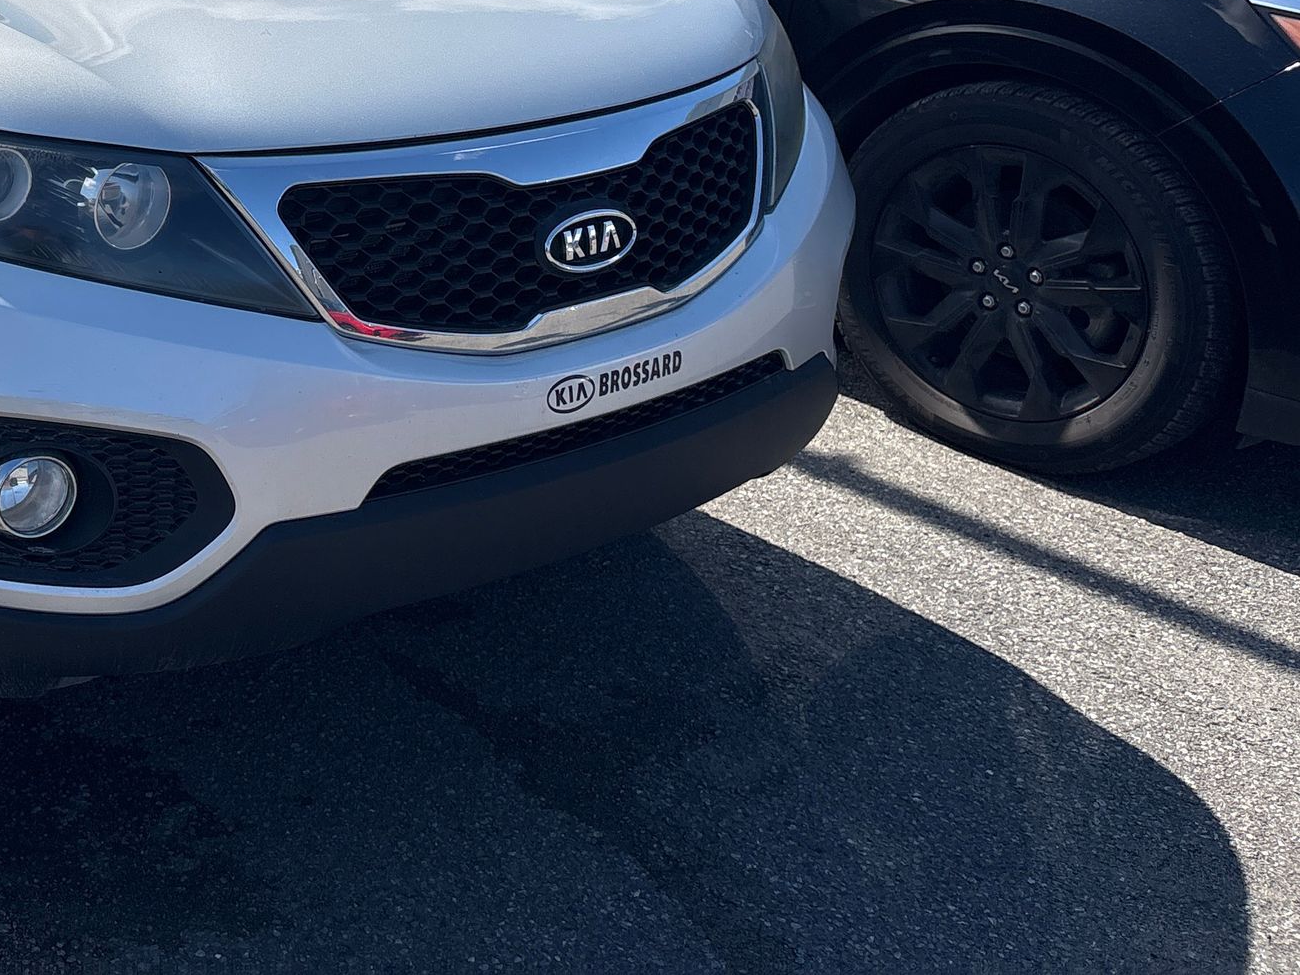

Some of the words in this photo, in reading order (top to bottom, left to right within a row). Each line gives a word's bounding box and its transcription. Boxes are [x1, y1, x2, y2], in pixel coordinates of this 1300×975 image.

[563, 220, 621, 261] KIA
[555, 382, 588, 407] KIA
[599, 350, 682, 396] BROSSARD
